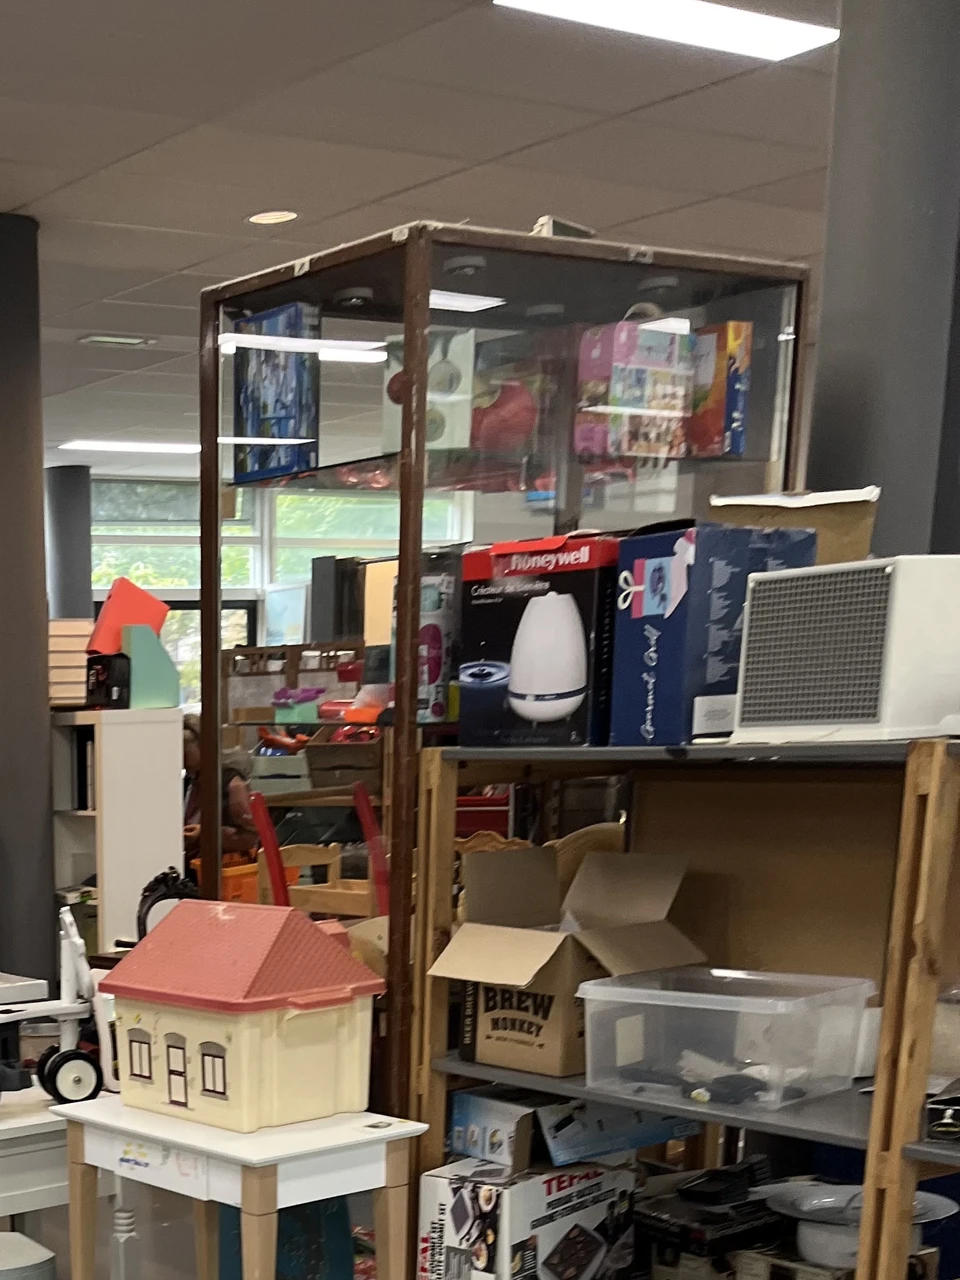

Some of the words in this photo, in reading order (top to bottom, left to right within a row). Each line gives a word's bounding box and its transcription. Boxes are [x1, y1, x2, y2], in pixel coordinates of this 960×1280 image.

[509, 545, 590, 571] Honeywell
[483, 986, 555, 1021] BREW
[490, 1016, 544, 1037] MONKEY
